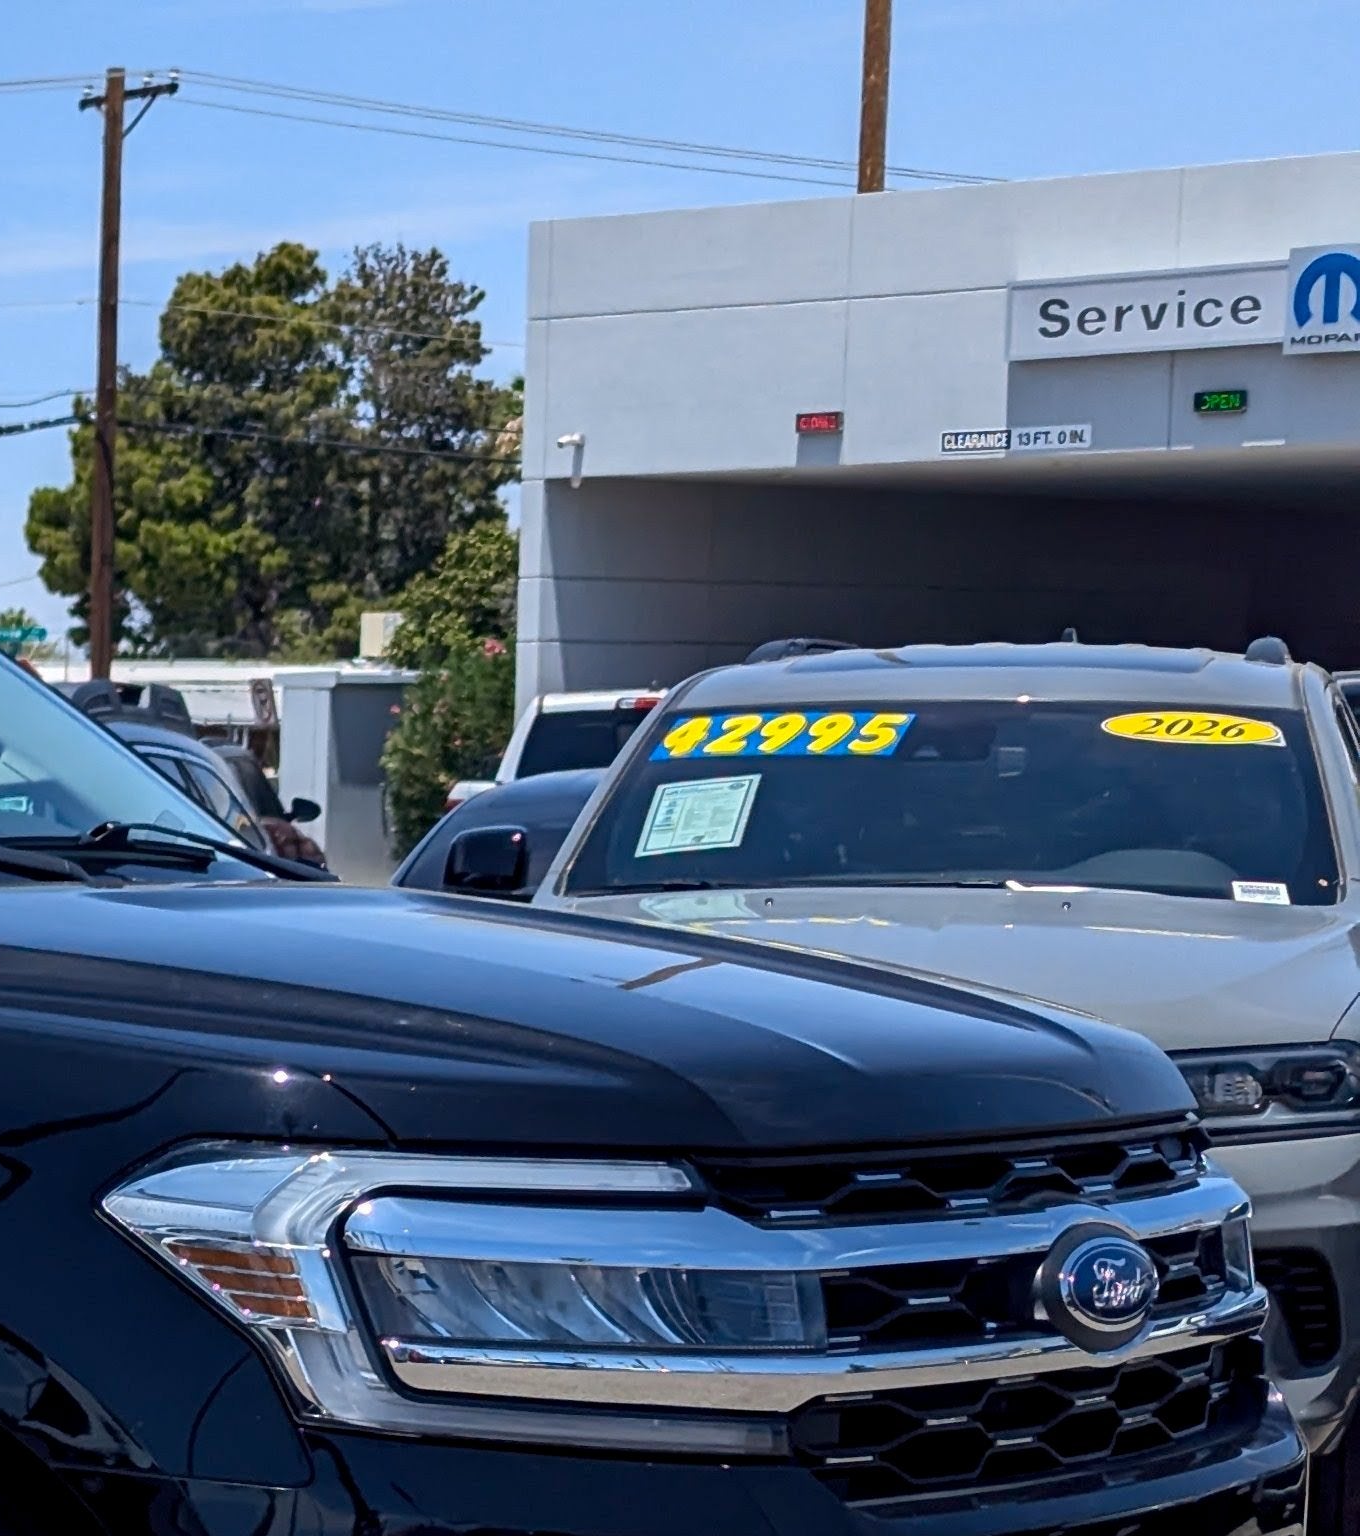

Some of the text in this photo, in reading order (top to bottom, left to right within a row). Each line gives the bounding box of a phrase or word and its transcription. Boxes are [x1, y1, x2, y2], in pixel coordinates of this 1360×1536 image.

[1038, 289, 1262, 338] Service
[944, 433, 1009, 449] CLEARANCE
[1017, 433, 1030, 446] 13
[663, 713, 909, 757] 42995
[1133, 718, 1251, 738] 2026
[1092, 1257, 1152, 1307] Ford
